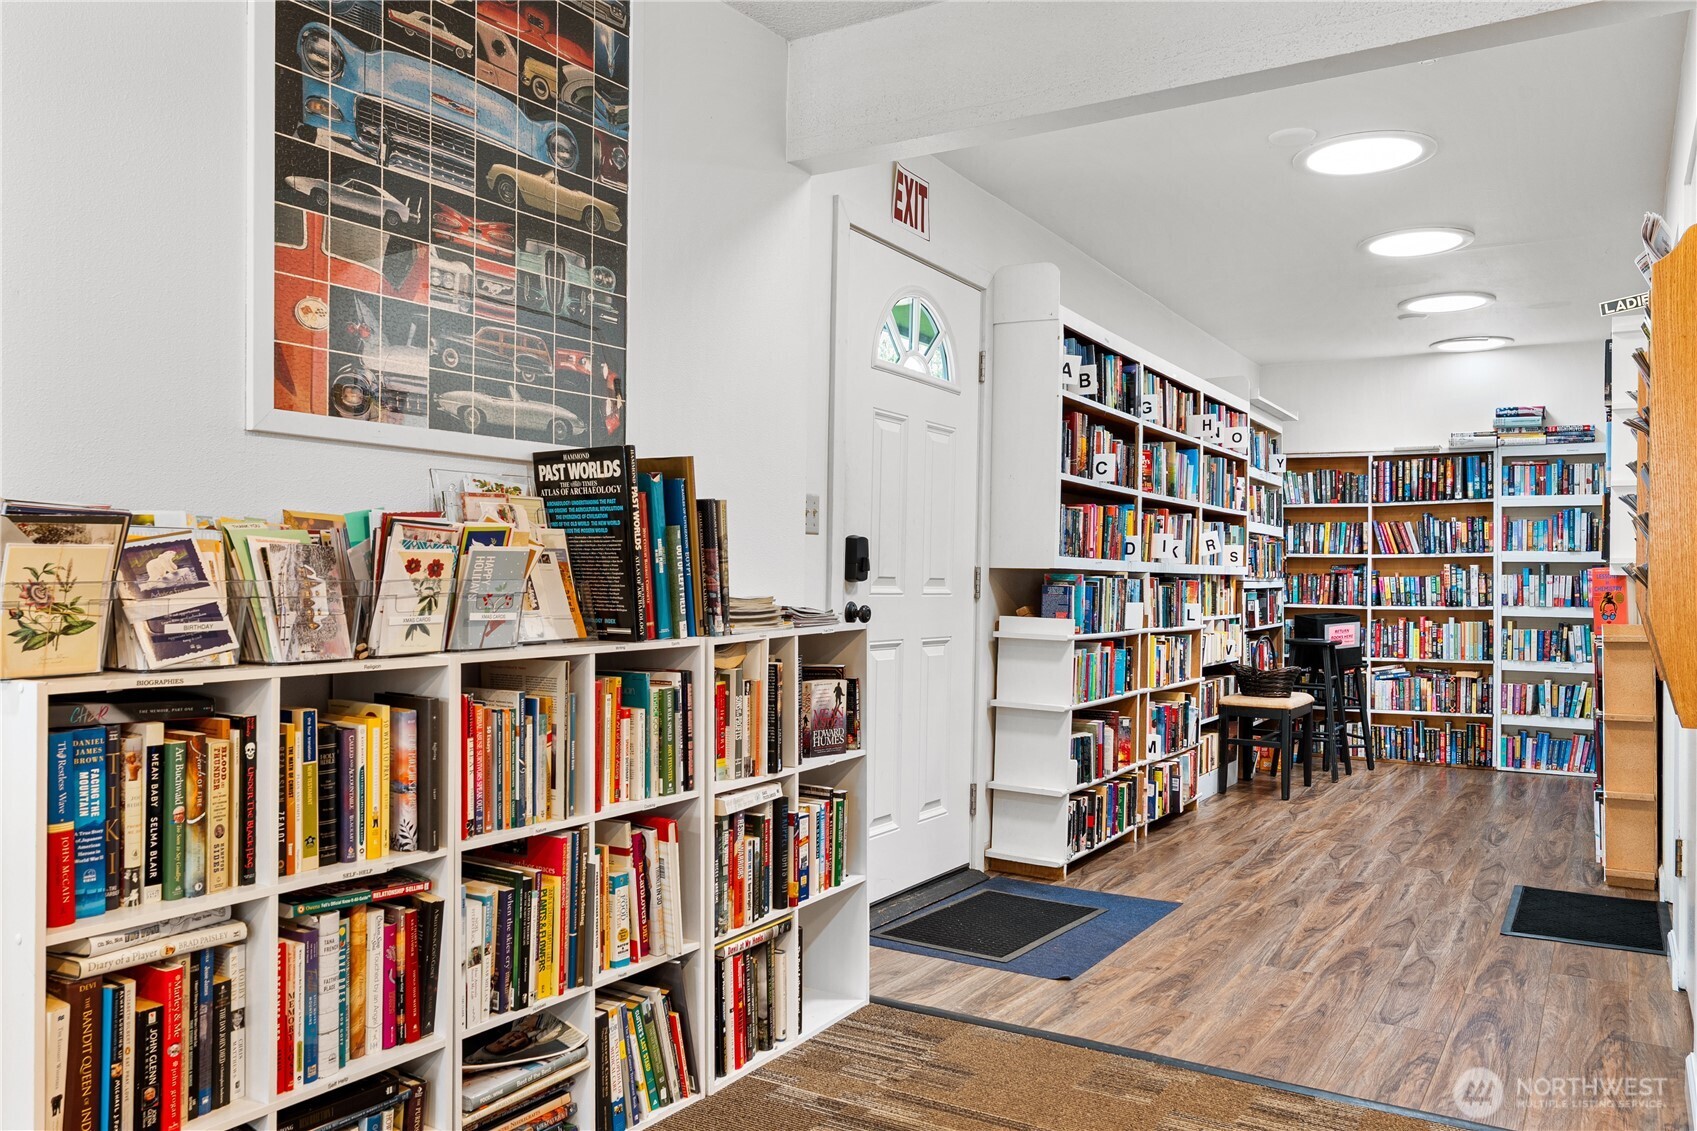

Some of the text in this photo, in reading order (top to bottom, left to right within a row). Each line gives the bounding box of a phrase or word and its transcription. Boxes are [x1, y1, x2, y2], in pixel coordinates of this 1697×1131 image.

[894, 169, 928, 233] EXIT
[1604, 294, 1649, 314] LADIE
[1063, 362, 1072, 378] A
[1080, 373, 1091, 388] B
[1142, 402, 1152, 414] G
[1203, 419, 1211, 431] H
[1232, 432, 1242, 443] O
[1096, 462, 1107, 475] C
[1277, 458, 1284, 468] Y
[538, 460, 621, 481] PAST WORLDS
[570, 485, 622, 495] ARCHAEOLOGY
[631, 486, 640, 508] PAST
[632, 511, 642, 550] WORLDS
[1126, 542, 1135, 555] D
[1206, 540, 1216, 551] R
[1230, 552, 1238, 562] S
[482, 556, 496, 586] HAPPY
[677, 561, 684, 572] OF
[636, 576, 641, 585] OF
[1187, 608, 1195, 621] L
[1225, 645, 1233, 655] V
[136, 678, 184, 686] BIOGRAPHIES
[813, 728, 844, 740] EDWARD
[73, 738, 105, 747] DANIEL
[813, 736, 845, 748] HUMES
[75, 747, 102, 756] JAMES
[74, 756, 104, 765] BROWN
[151, 753, 159, 780] MEAN
[56, 741, 67, 814] The Restless Wave
[175, 747, 185, 806] Art Buchwald
[79, 772, 89, 817] MOUNTAIN
[90, 768, 100, 817] FACING THE
[150, 816, 158, 848] SELMA
[61, 836, 69, 862] JOHN
[150, 851, 158, 878] BLAIR
[343, 869, 373, 879] SELF-HELP
[373, 884, 424, 899] RELATIONSHIP SELLING
[88, 959, 114, 972] Diary
[115, 956, 125, 965] of
[132, 950, 158, 962] Player
[178, 940, 199, 950] BRAD
[200, 932, 229, 945] PAISLEY
[539, 931, 547, 972] FLOWERS
[728, 945, 738, 955] Devil
[752, 935, 764, 946] Heels
[79, 982, 96, 992] DEVI
[172, 981, 181, 1012] Marley
[174, 1024, 181, 1038] Me
[635, 1010, 644, 1038] CLUTTER'S
[149, 1054, 157, 1085] GLENN
[328, 1077, 349, 1089] Self Help
